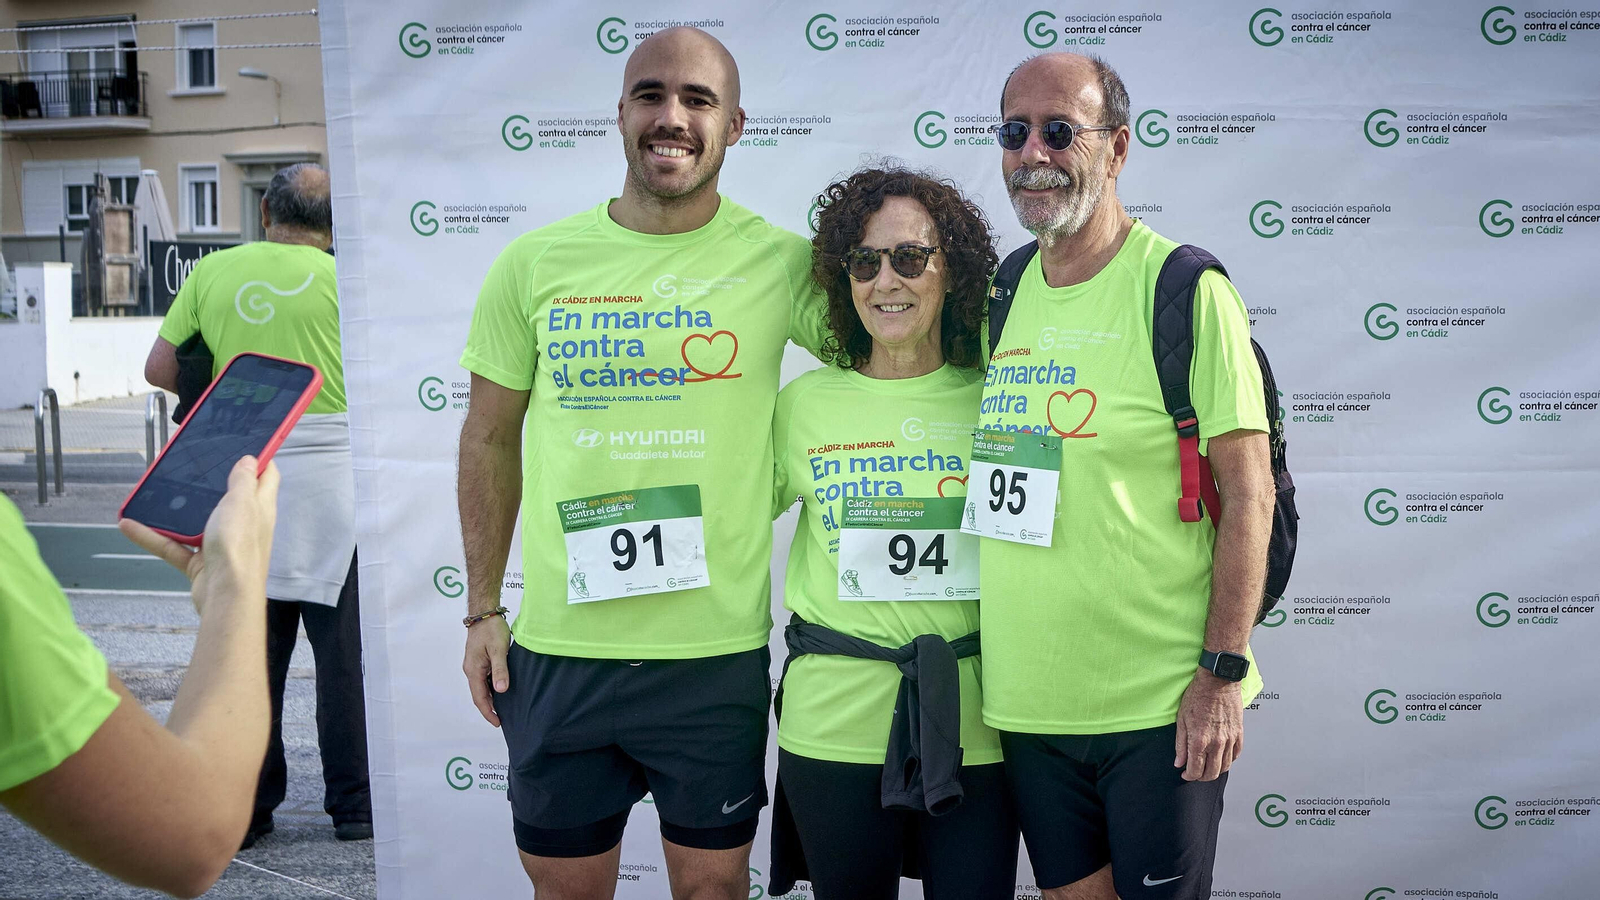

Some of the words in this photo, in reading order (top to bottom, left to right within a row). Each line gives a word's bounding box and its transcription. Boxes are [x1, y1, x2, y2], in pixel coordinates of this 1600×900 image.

[845, 15, 895, 26] asociación
[896, 15, 940, 27] española
[1064, 13, 1116, 23] asociación
[1117, 12, 1162, 24] española
[1291, 10, 1344, 21] asociación
[1346, 10, 1392, 22] española
[435, 23, 483, 34] asociación
[484, 23, 522, 34] española
[845, 27, 875, 37] contra
[877, 27, 886, 36] el
[887, 27, 920, 36] cáncer
[1064, 25, 1096, 34] contra
[1097, 24, 1107, 34] el
[1108, 24, 1142, 34] cáncer
[1291, 23, 1324, 32] contra
[1325, 22, 1335, 32] el
[1336, 22, 1371, 32] cáncer
[436, 35, 466, 45] contra
[467, 34, 475, 44] el
[476, 34, 505, 44] cáncer
[858, 38, 885, 48] Cádiz
[1078, 36, 1106, 45] Cádiz
[1305, 33, 1334, 44] Cádiz
[437, 47, 450, 55] en
[450, 45, 475, 55] Cádiz
[538, 118, 582, 126] asociación
[1176, 112, 1229, 122] asociación
[1230, 112, 1276, 124] española
[1406, 111, 1460, 122] asociación
[1462, 111, 1508, 124] española
[568, 128, 575, 137] el
[1176, 124, 1209, 133] contra
[1210, 124, 1220, 133] el
[1221, 124, 1256, 133] cáncer
[1406, 124, 1439, 133] contra
[1441, 123, 1450, 133] el
[1452, 123, 1487, 133] cáncer
[1191, 135, 1219, 145] Cádiz
[1421, 135, 1450, 145] Cádiz
[443, 203, 487, 213] asociación
[488, 203, 527, 214] española
[444, 214, 471, 223] contra
[472, 214, 480, 223] el
[481, 214, 510, 223] cáncer
[456, 225, 480, 234] Cádiz
[562, 296, 587, 304] CÁDIZ
[1406, 306, 1459, 315] asociación
[1460, 305, 1506, 317] española
[549, 308, 582, 332] En
[592, 305, 712, 329] marcha
[1406, 317, 1438, 326] contra
[1440, 317, 1449, 326] el
[1451, 317, 1486, 326] cáncer
[1420, 328, 1449, 338] Cádiz
[548, 334, 645, 360] contra
[553, 364, 574, 388] el
[580, 362, 691, 386] cáncer
[999, 359, 1076, 385] marcha
[1292, 391, 1344, 401] asociación
[1346, 391, 1391, 402] española
[1292, 403, 1324, 412] contra
[1326, 402, 1335, 412] el
[1337, 402, 1371, 412] cáncer
[1306, 413, 1334, 423] Cádiz
[610, 429, 705, 445] HYUNDAI
[992, 434, 1015, 443] marcha
[818, 444, 841, 454] CÁDIZ
[857, 440, 895, 449] MARCHA
[987, 441, 993, 450] el
[993, 442, 1015, 452] cáncer
[610, 450, 668, 460] Guadalete
[672, 450, 705, 459] Motor
[810, 456, 840, 481] En
[850, 449, 964, 473] marcha
[814, 477, 903, 505] contra
[989, 468, 1028, 515] 95
[1405, 491, 1458, 501] asociación
[1459, 491, 1504, 503] española
[562, 501, 587, 511] Cádiz
[847, 499, 872, 507] Cádiz
[1405, 503, 1437, 512] contra
[1439, 503, 1448, 512] el
[1450, 502, 1484, 512] cáncer
[566, 509, 595, 520] contra
[892, 508, 924, 517] cáncer
[822, 506, 839, 532] el
[1420, 514, 1448, 523] Cádiz
[610, 524, 664, 571] 91
[888, 534, 948, 576] 94
[1405, 691, 1456, 701] asociación
[1458, 691, 1502, 702] española
[1405, 703, 1436, 711] contra
[1438, 702, 1447, 711] el
[1448, 702, 1482, 711] cáncer
[1419, 712, 1446, 722] Cádiz
[1295, 797, 1345, 806] asociación
[1347, 797, 1391, 808] española
[1295, 807, 1326, 816] contra
[1327, 807, 1337, 816] el
[1338, 807, 1371, 816] cáncer
[1309, 817, 1336, 826] Cádiz
